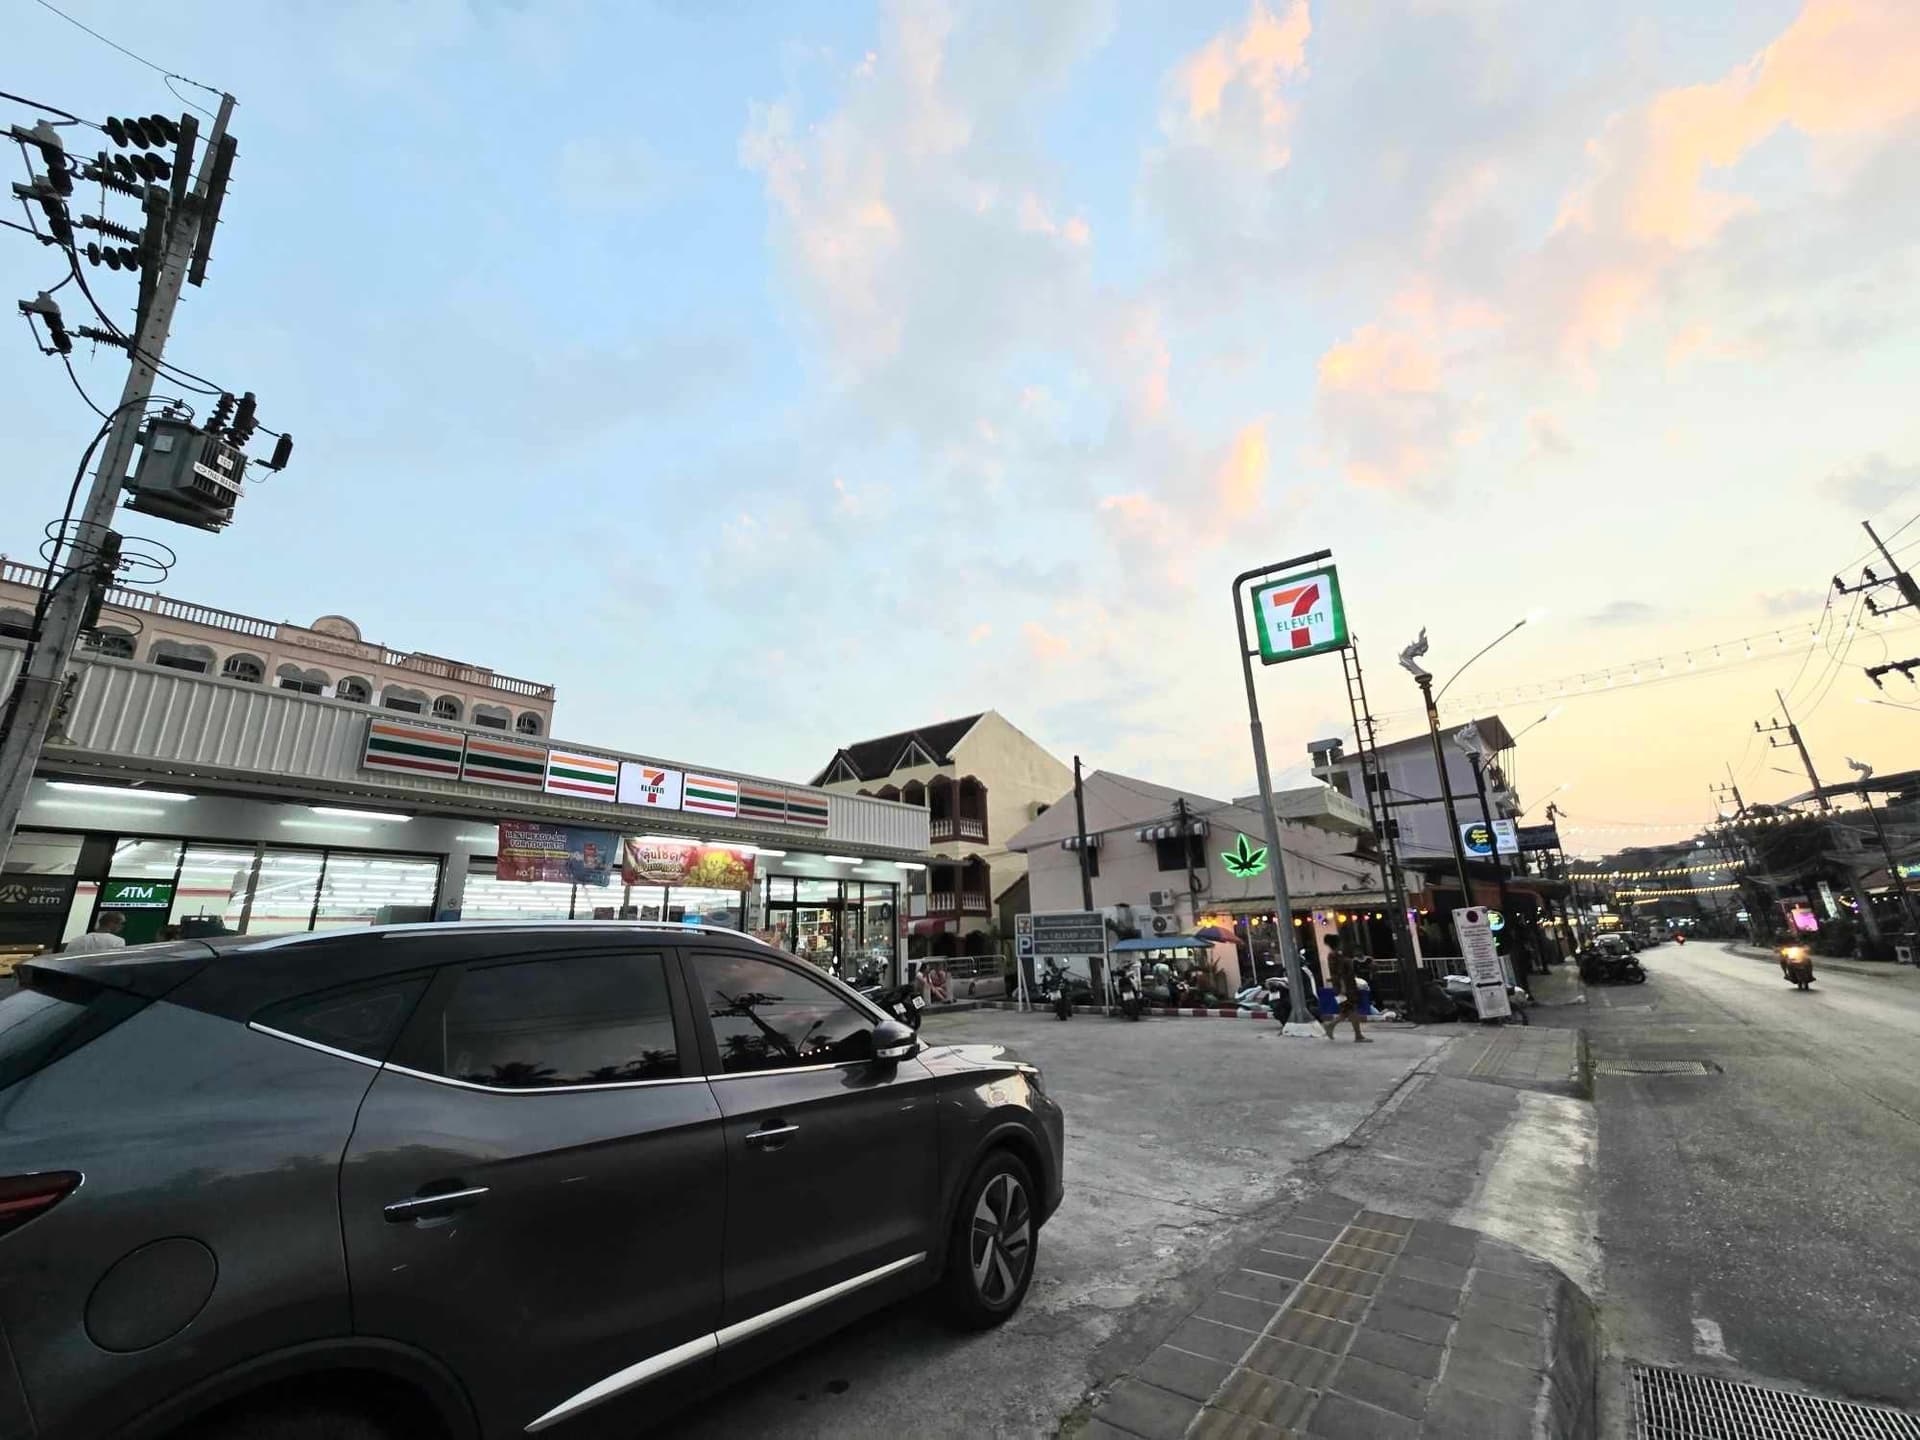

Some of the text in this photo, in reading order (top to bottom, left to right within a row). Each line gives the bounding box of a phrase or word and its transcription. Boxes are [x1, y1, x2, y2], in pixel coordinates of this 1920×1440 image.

[1273, 583, 1320, 649] 7
[643, 769, 665, 803] 7
[28, 895, 61, 905] atm
[115, 886, 154, 898] ATM
[1020, 936, 1031, 954] P
